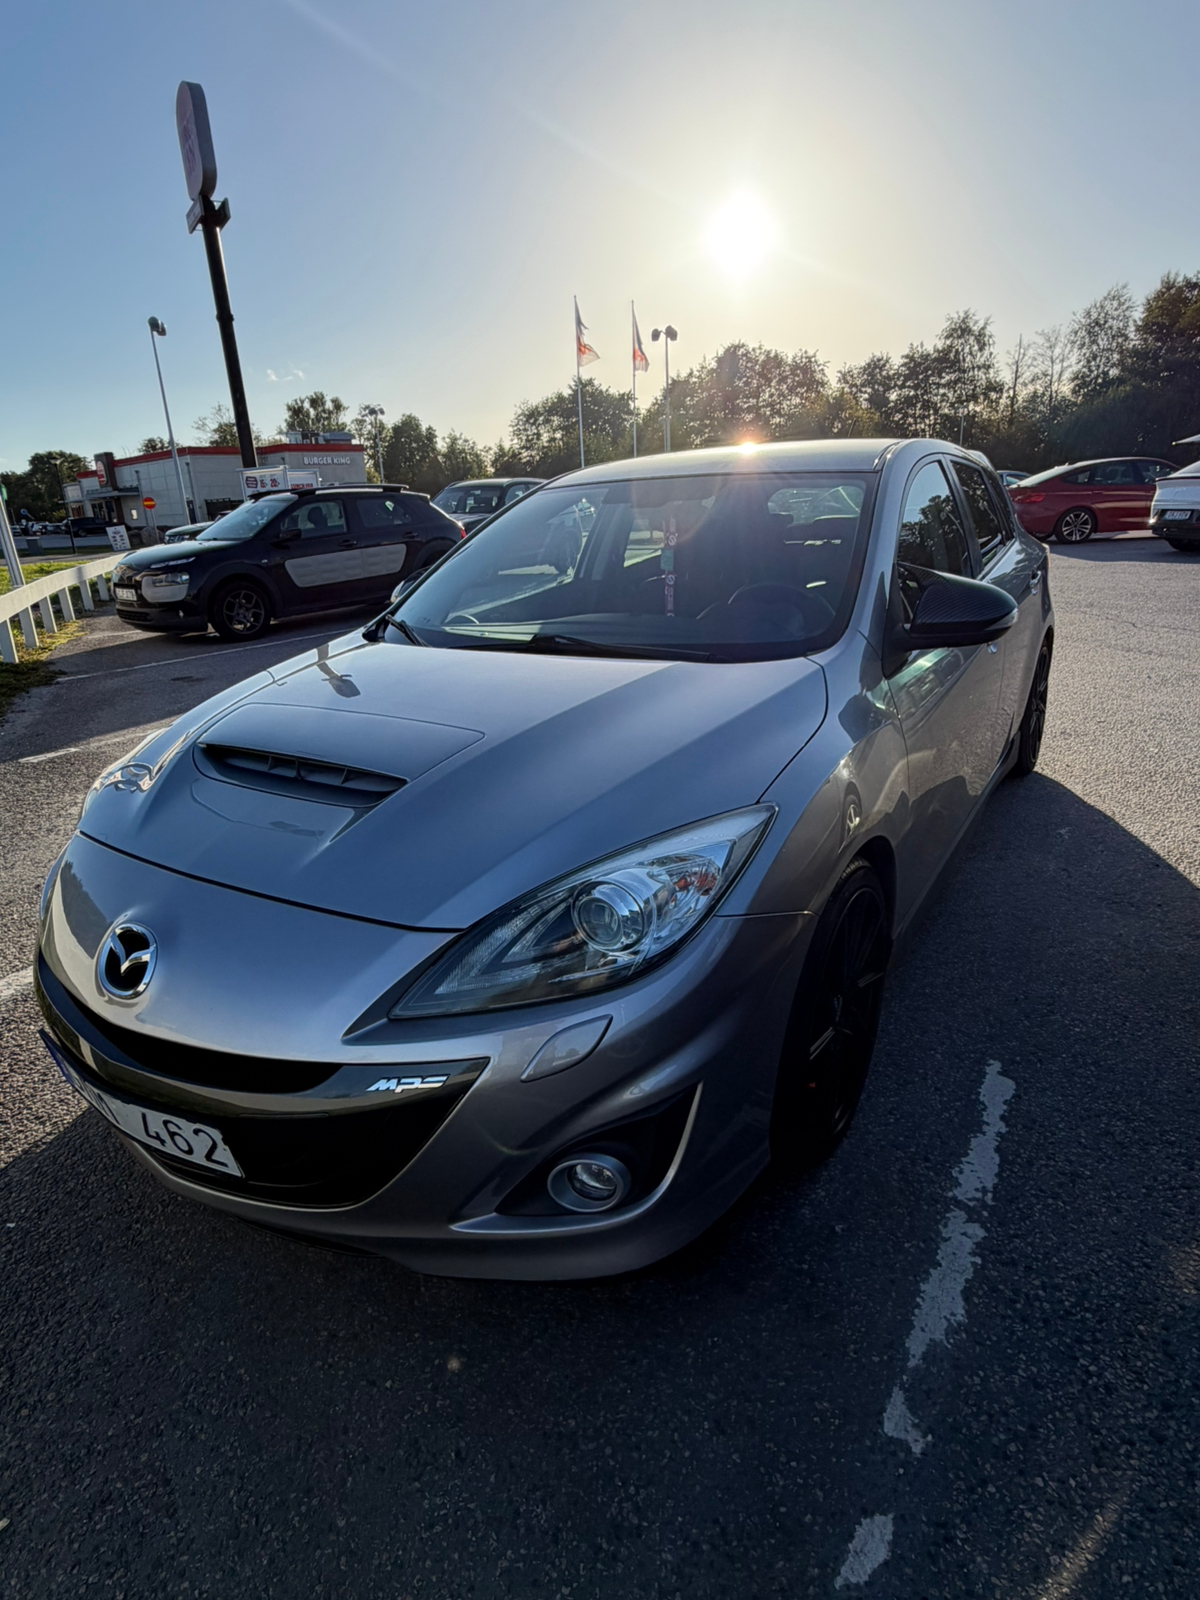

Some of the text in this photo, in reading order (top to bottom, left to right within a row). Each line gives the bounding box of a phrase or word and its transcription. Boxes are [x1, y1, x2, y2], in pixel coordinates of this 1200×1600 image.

[303, 456, 351, 465] BURGER KING
[365, 1075, 449, 1094] MPS
[140, 1111, 229, 1169] 462
